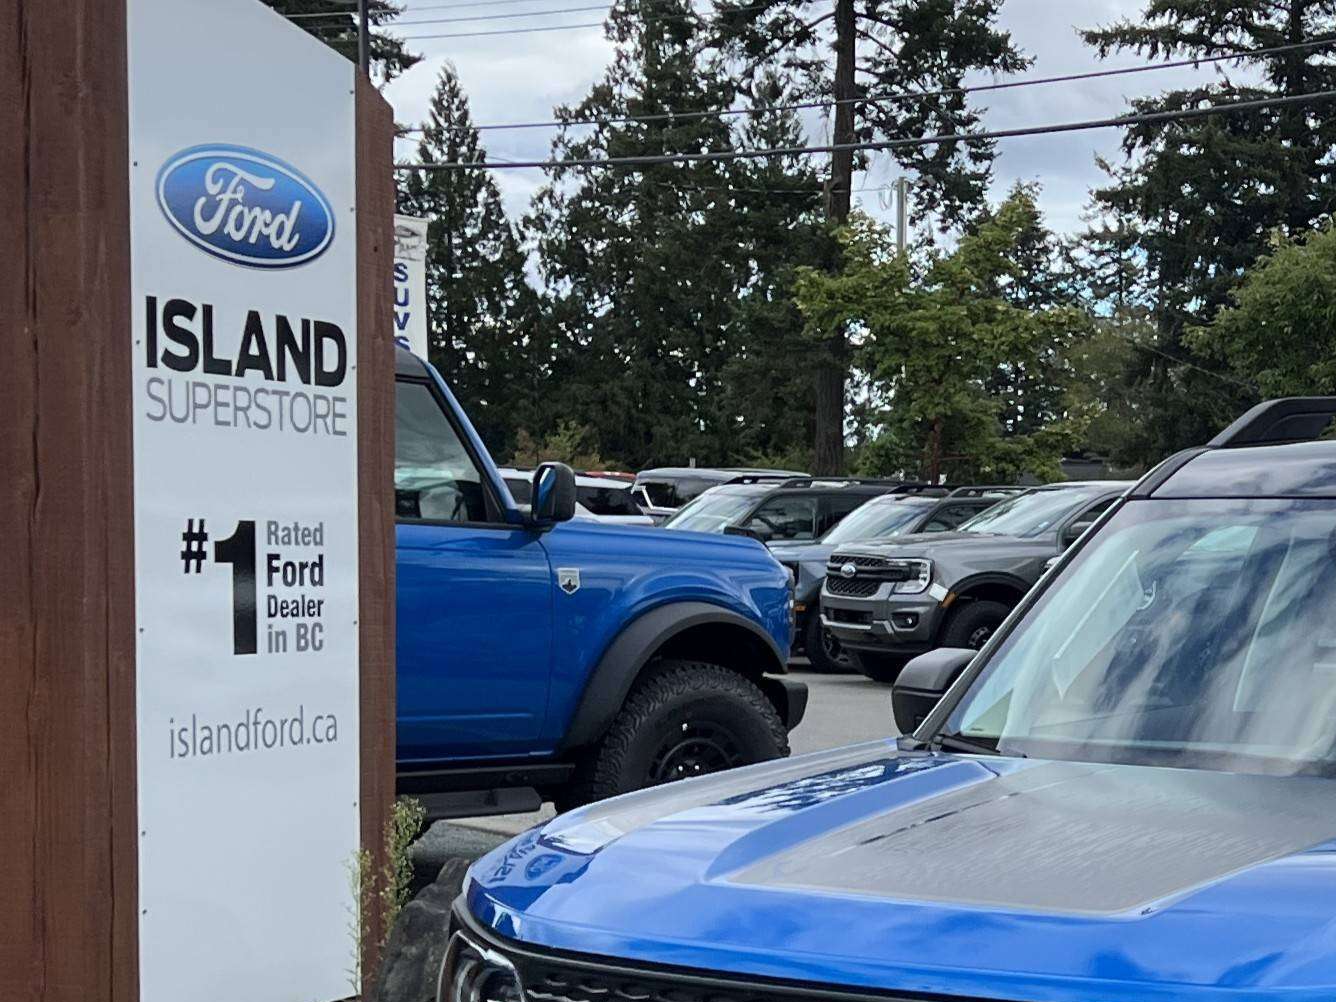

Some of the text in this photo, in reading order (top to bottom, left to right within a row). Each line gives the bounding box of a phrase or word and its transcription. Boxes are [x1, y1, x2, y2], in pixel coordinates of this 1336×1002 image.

[194, 162, 302, 252] Ford
[145, 295, 347, 387] ISLAND
[146, 377, 347, 436] SUPERSTORE
[266, 520, 324, 547] Rated
[181, 518, 257, 655] #1
[266, 553, 324, 587] Ford
[266, 594, 324, 618] Dealer
[267, 622, 323, 654] in BC
[170, 705, 338, 758] islandford.ca
